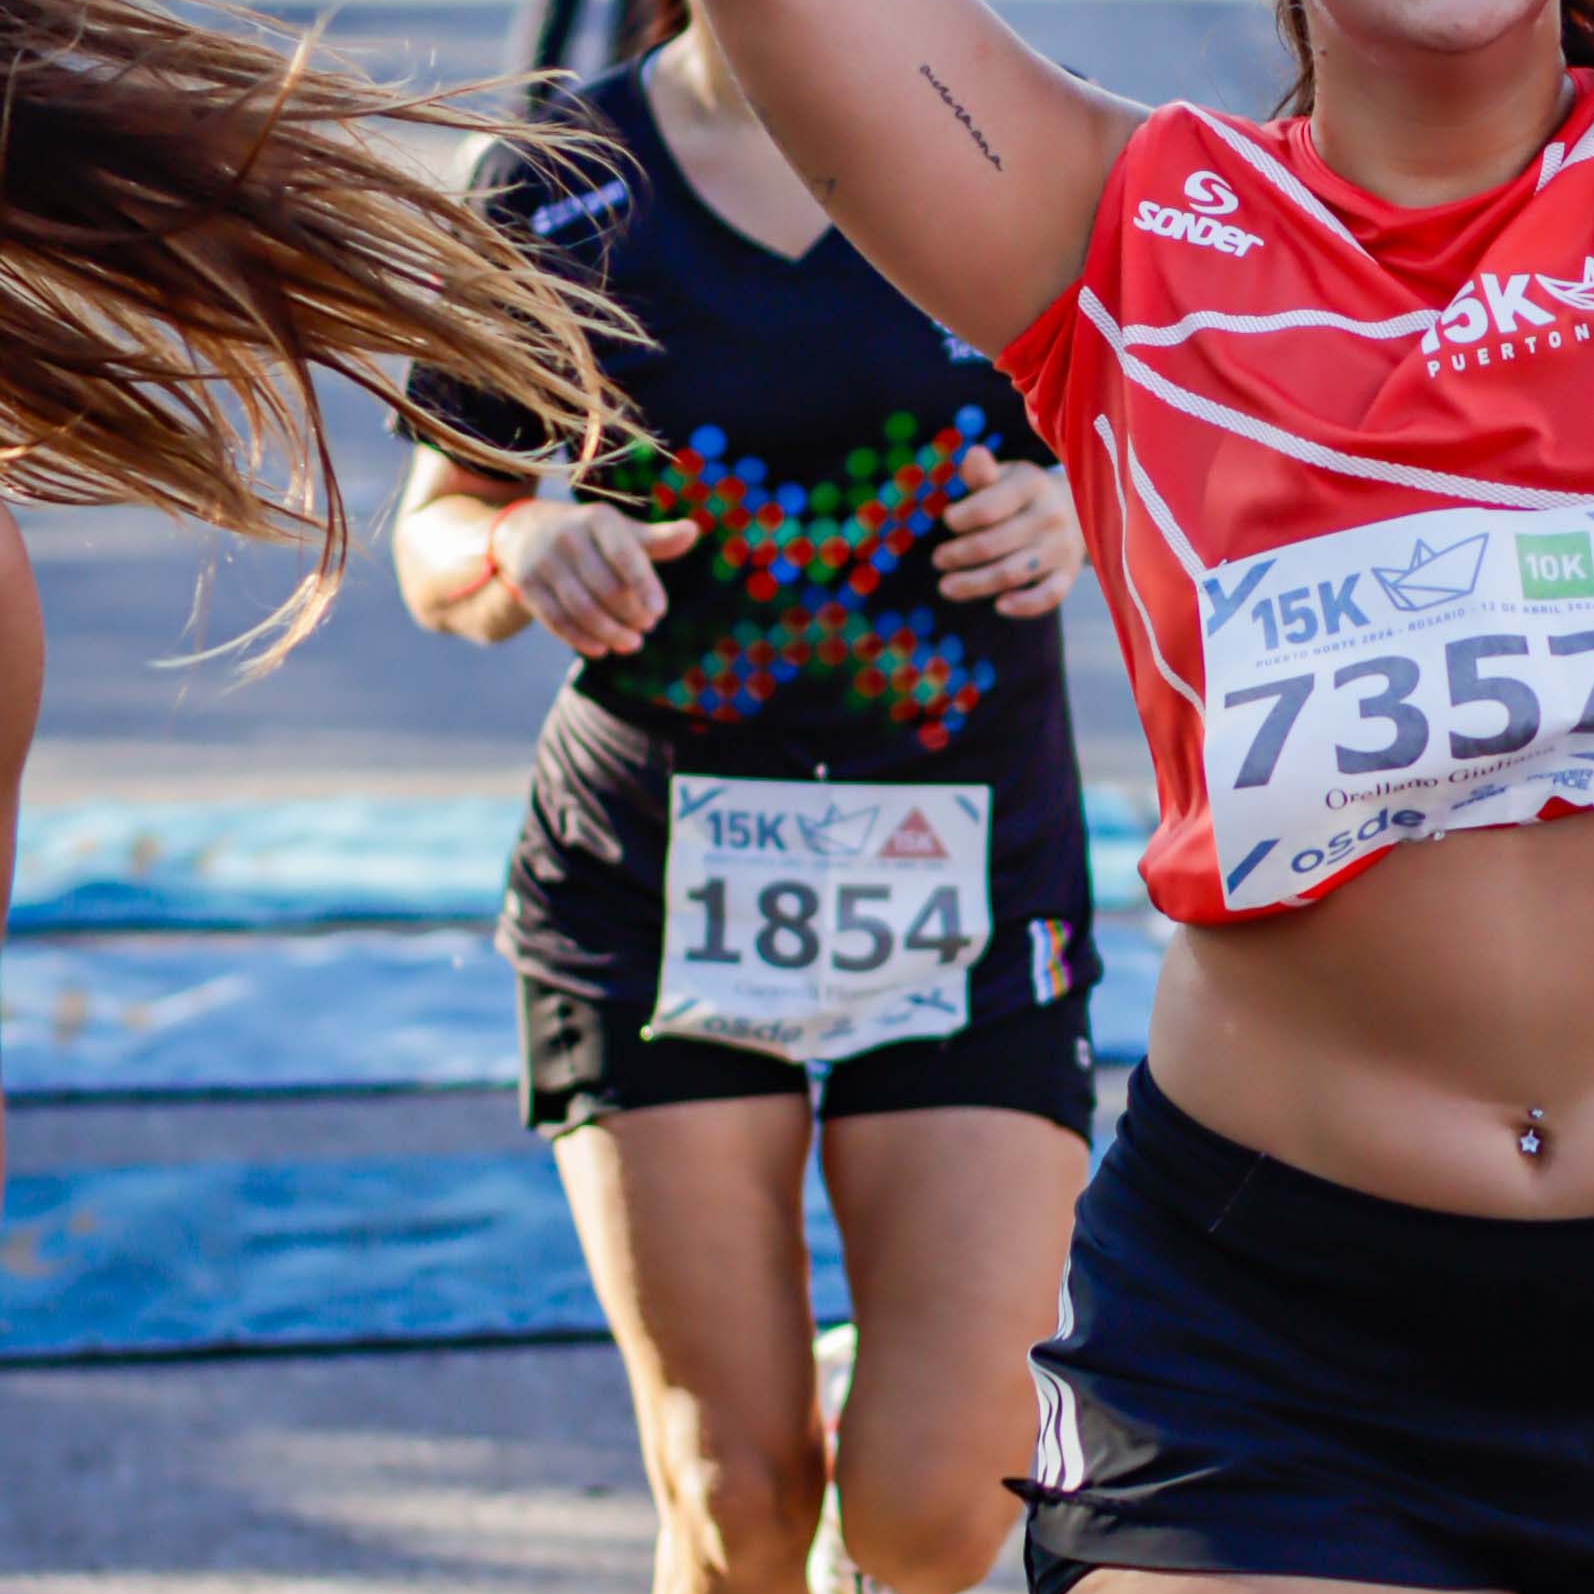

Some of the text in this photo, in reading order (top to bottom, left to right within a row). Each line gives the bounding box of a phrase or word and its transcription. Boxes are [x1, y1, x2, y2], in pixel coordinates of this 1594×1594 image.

[1525, 552, 1588, 581] 10K
[1250, 572, 1371, 651] 15K
[705, 809, 787, 852] 15K
[684, 876, 972, 973] 1854
